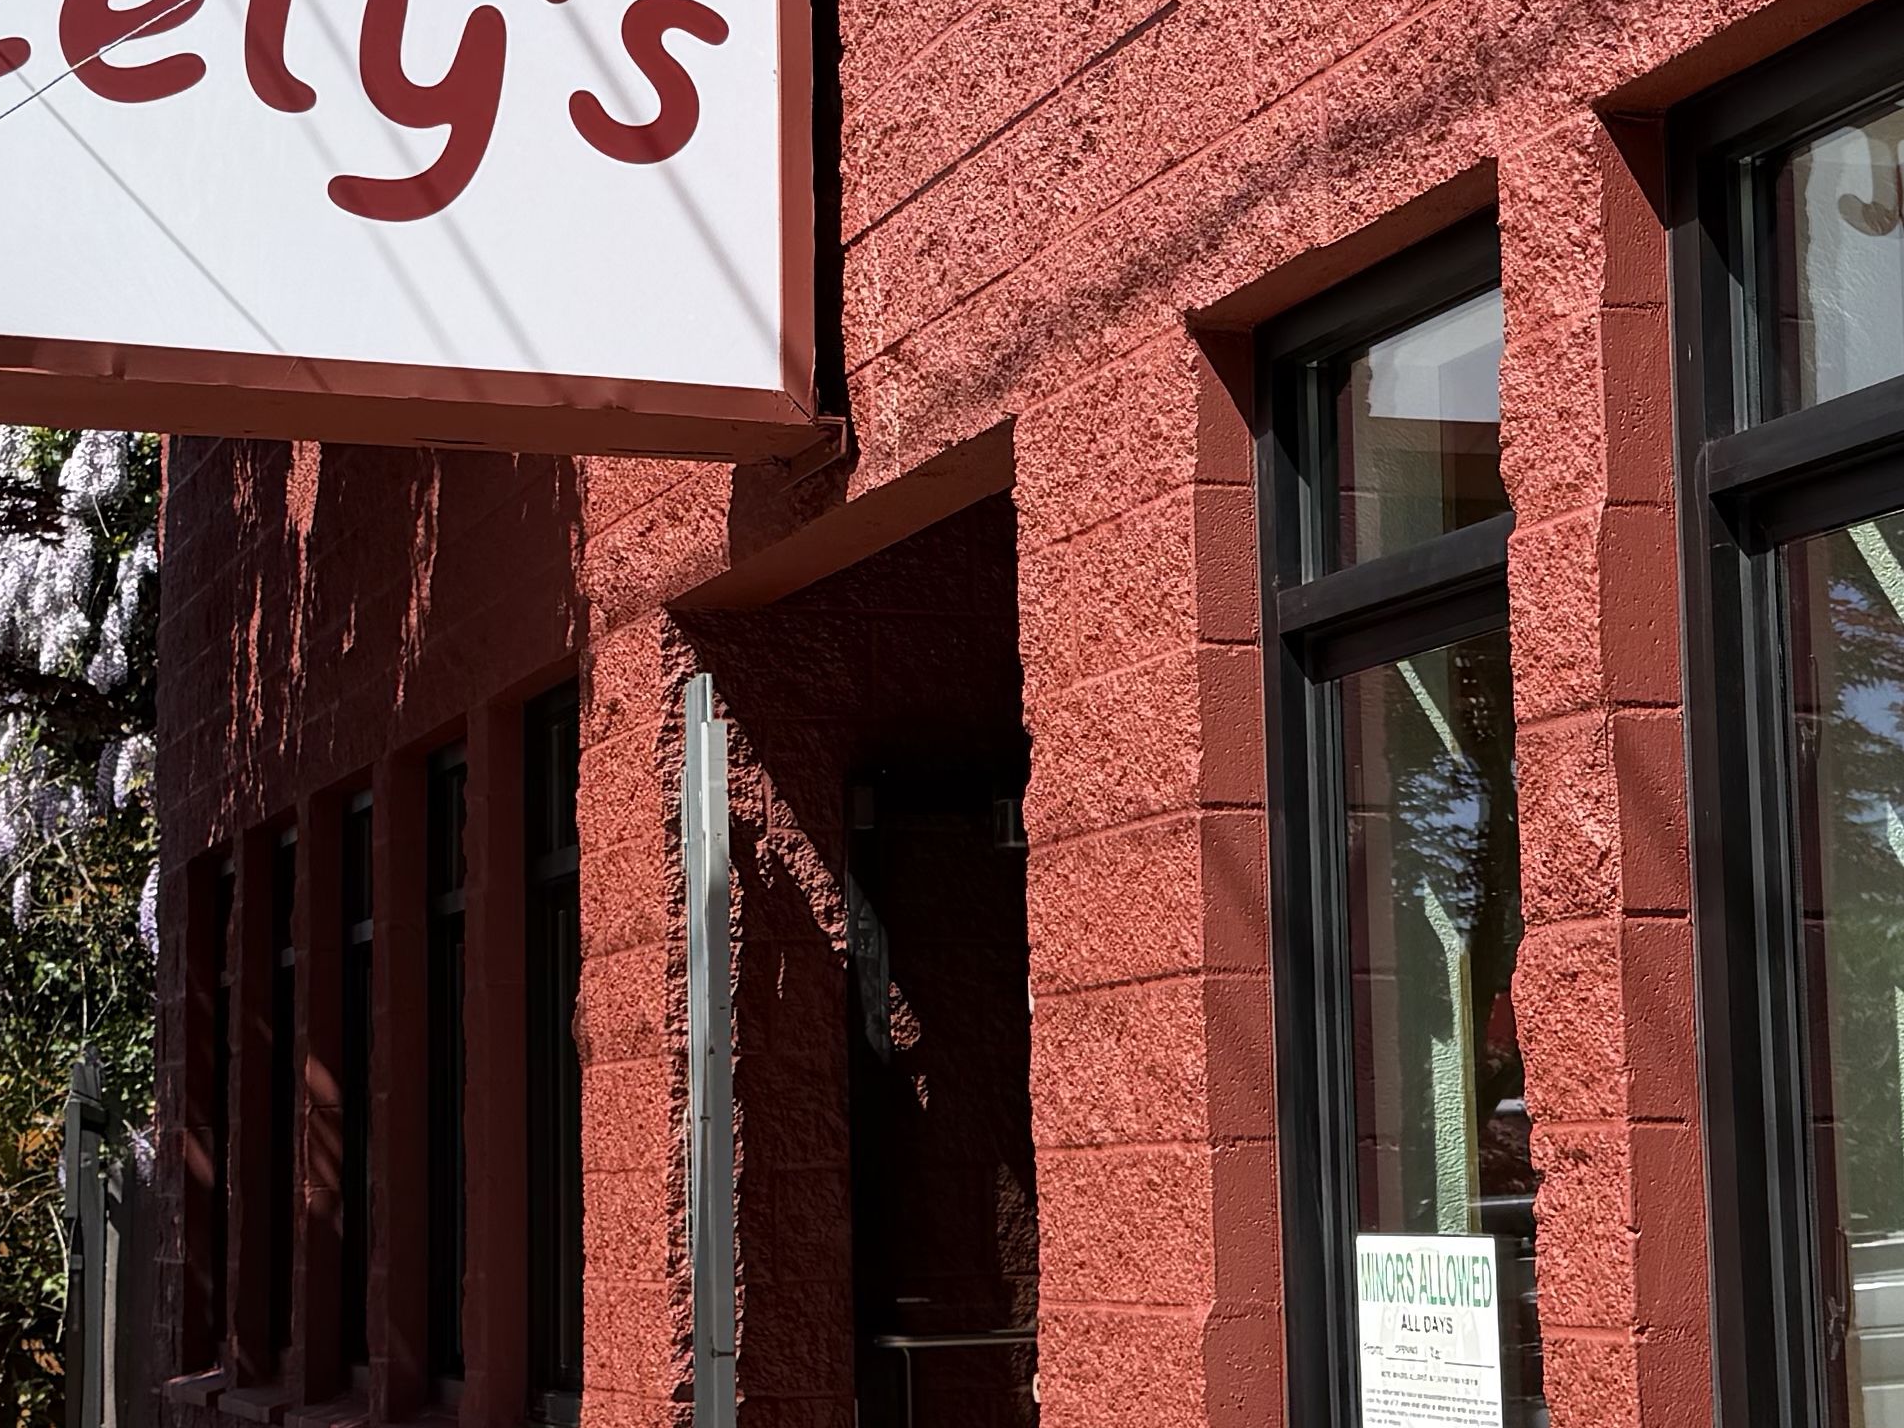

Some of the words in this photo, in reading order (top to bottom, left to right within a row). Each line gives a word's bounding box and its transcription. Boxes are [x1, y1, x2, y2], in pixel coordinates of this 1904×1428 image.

[1361, 1252, 1415, 1304] MINORS
[1419, 1253, 1492, 1308] ALLOWED
[1401, 1313, 1421, 1333] ALL
[1423, 1315, 1453, 1334] DAYS
